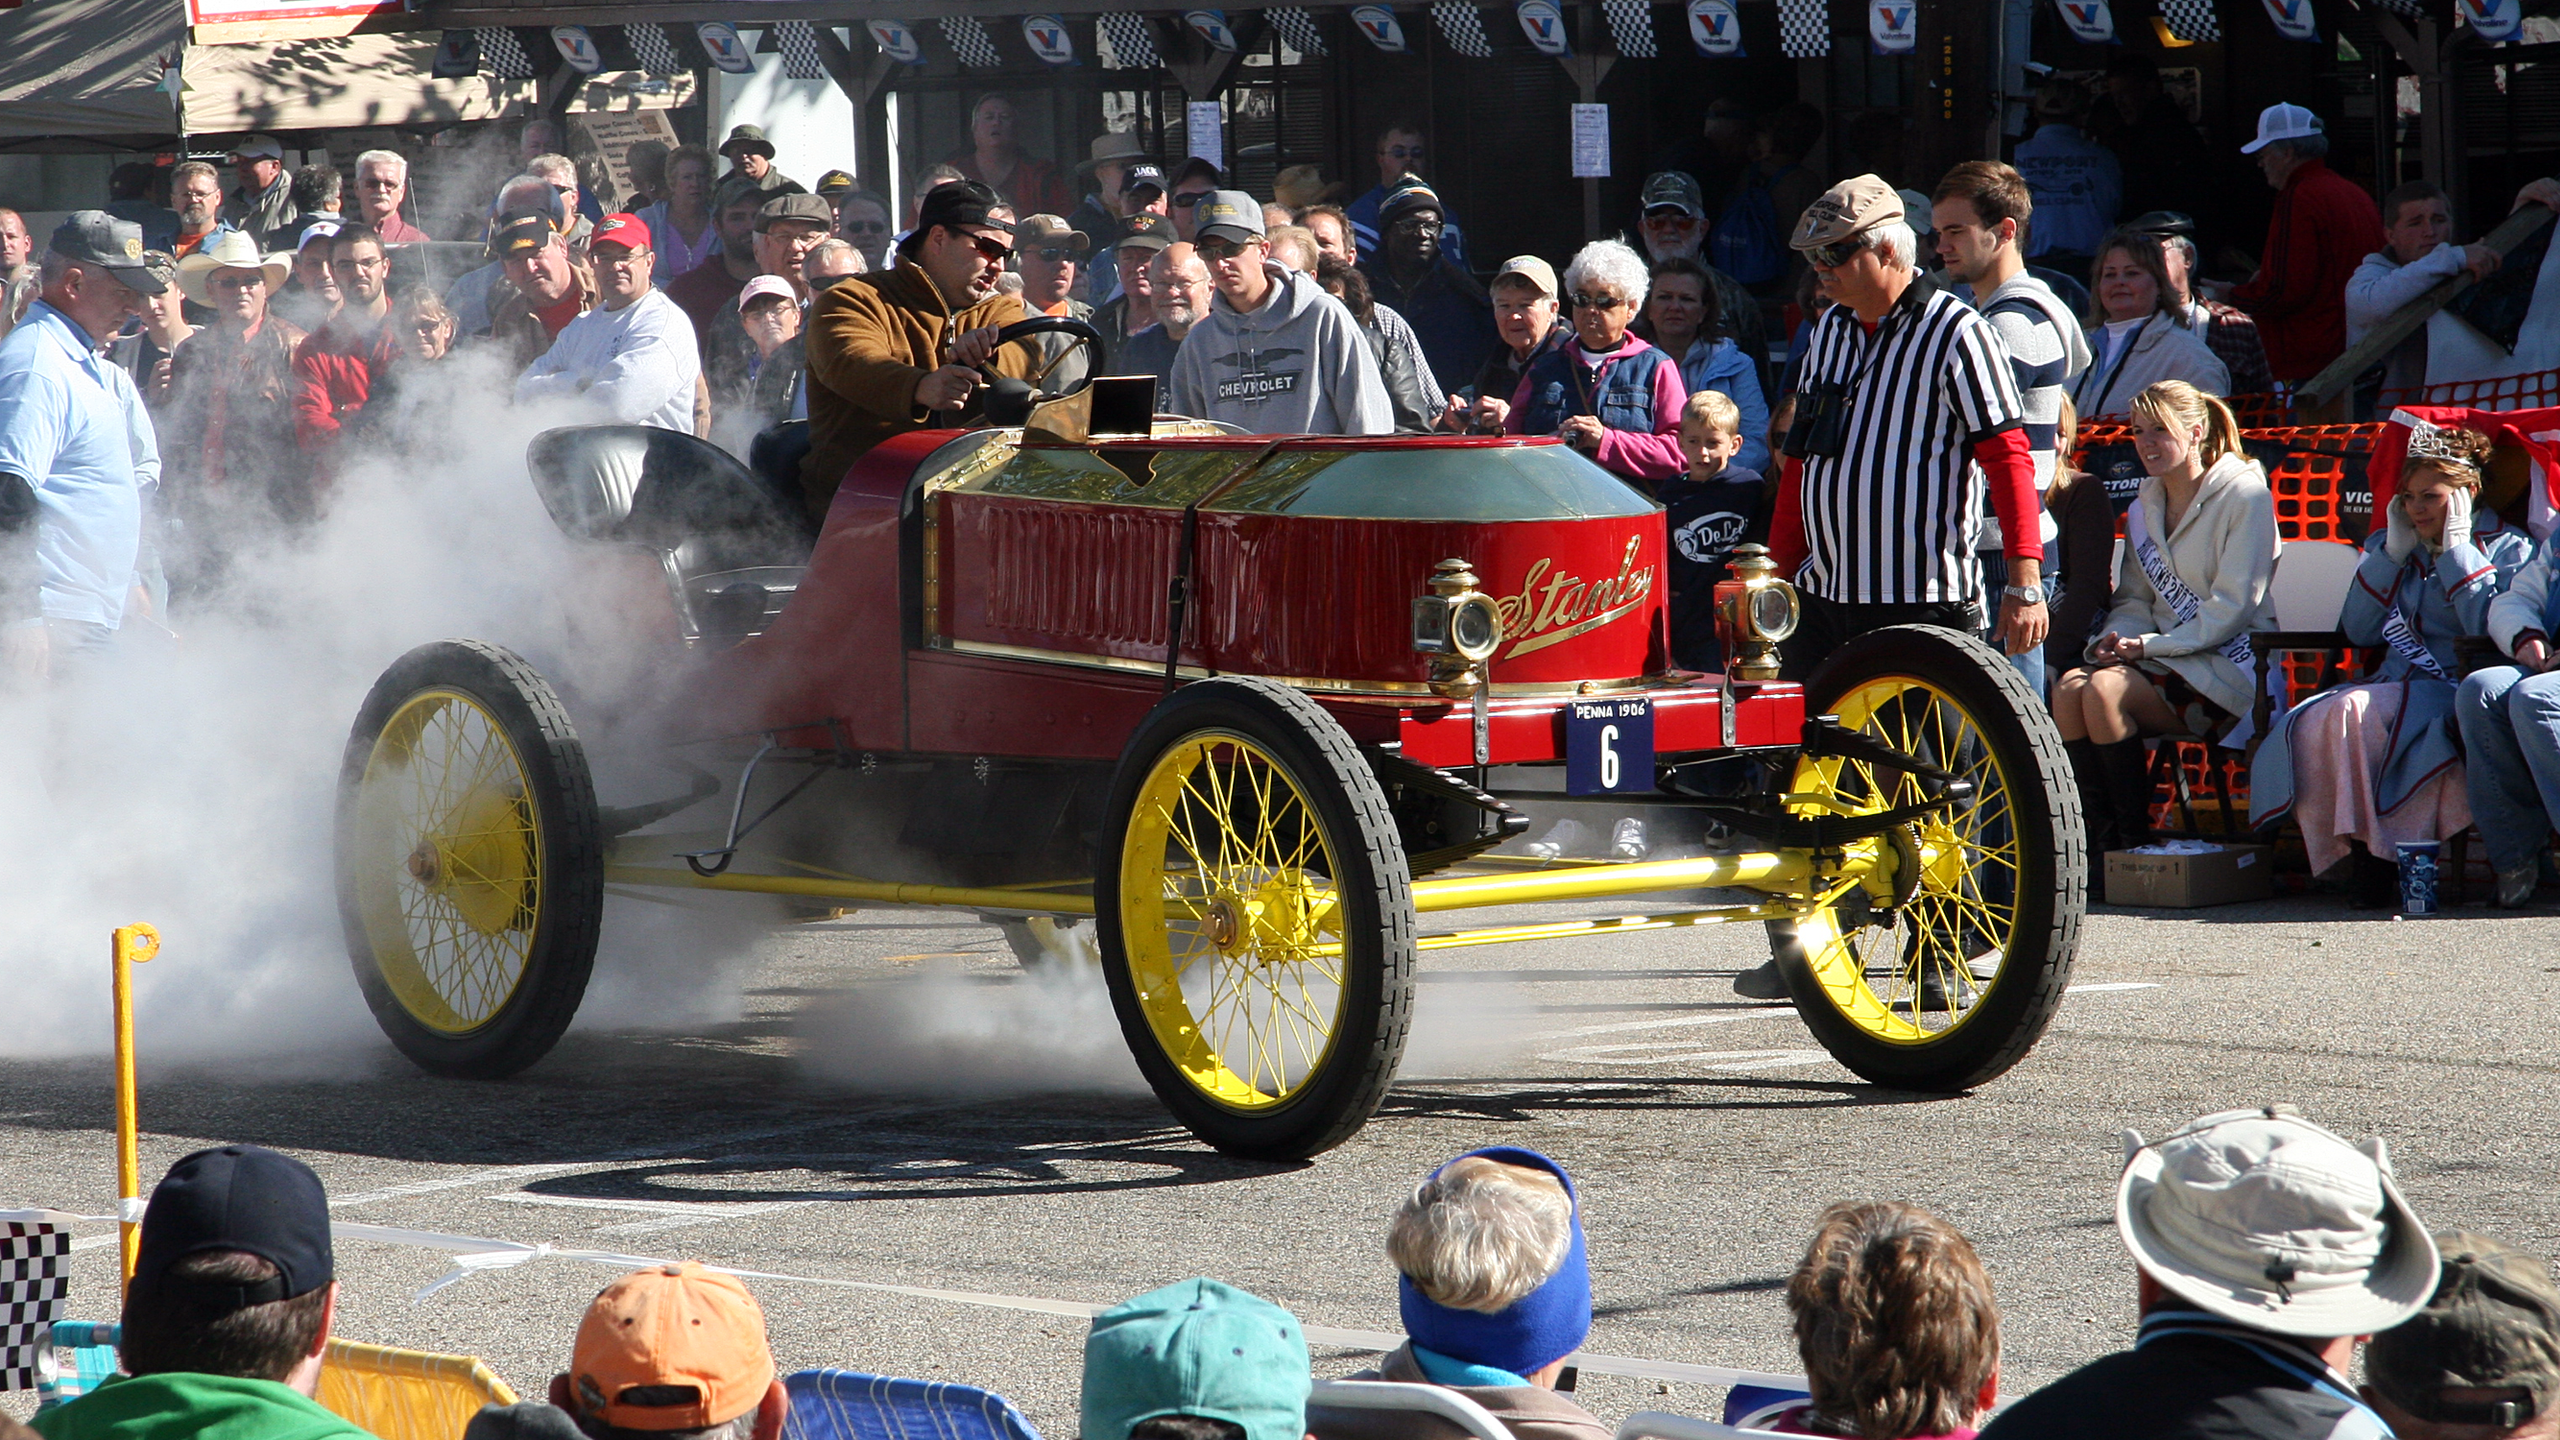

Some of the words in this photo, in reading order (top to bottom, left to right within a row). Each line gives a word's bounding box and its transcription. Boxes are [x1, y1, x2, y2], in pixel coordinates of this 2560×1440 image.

[1880, 32, 1911, 41] Valvoline
[1134, 166, 1159, 178] JACK
[1218, 376, 1293, 398] CHEVROLET
[2345, 491, 2374, 505] VIC
[1496, 533, 1656, 645] Stanley
[2163, 581, 2189, 610] 2ND
[2383, 622, 2428, 662] QUEEN
[1576, 705, 1614, 720] PENNA
[1618, 703, 1646, 718] 1906
[1600, 724, 1620, 789] 6
